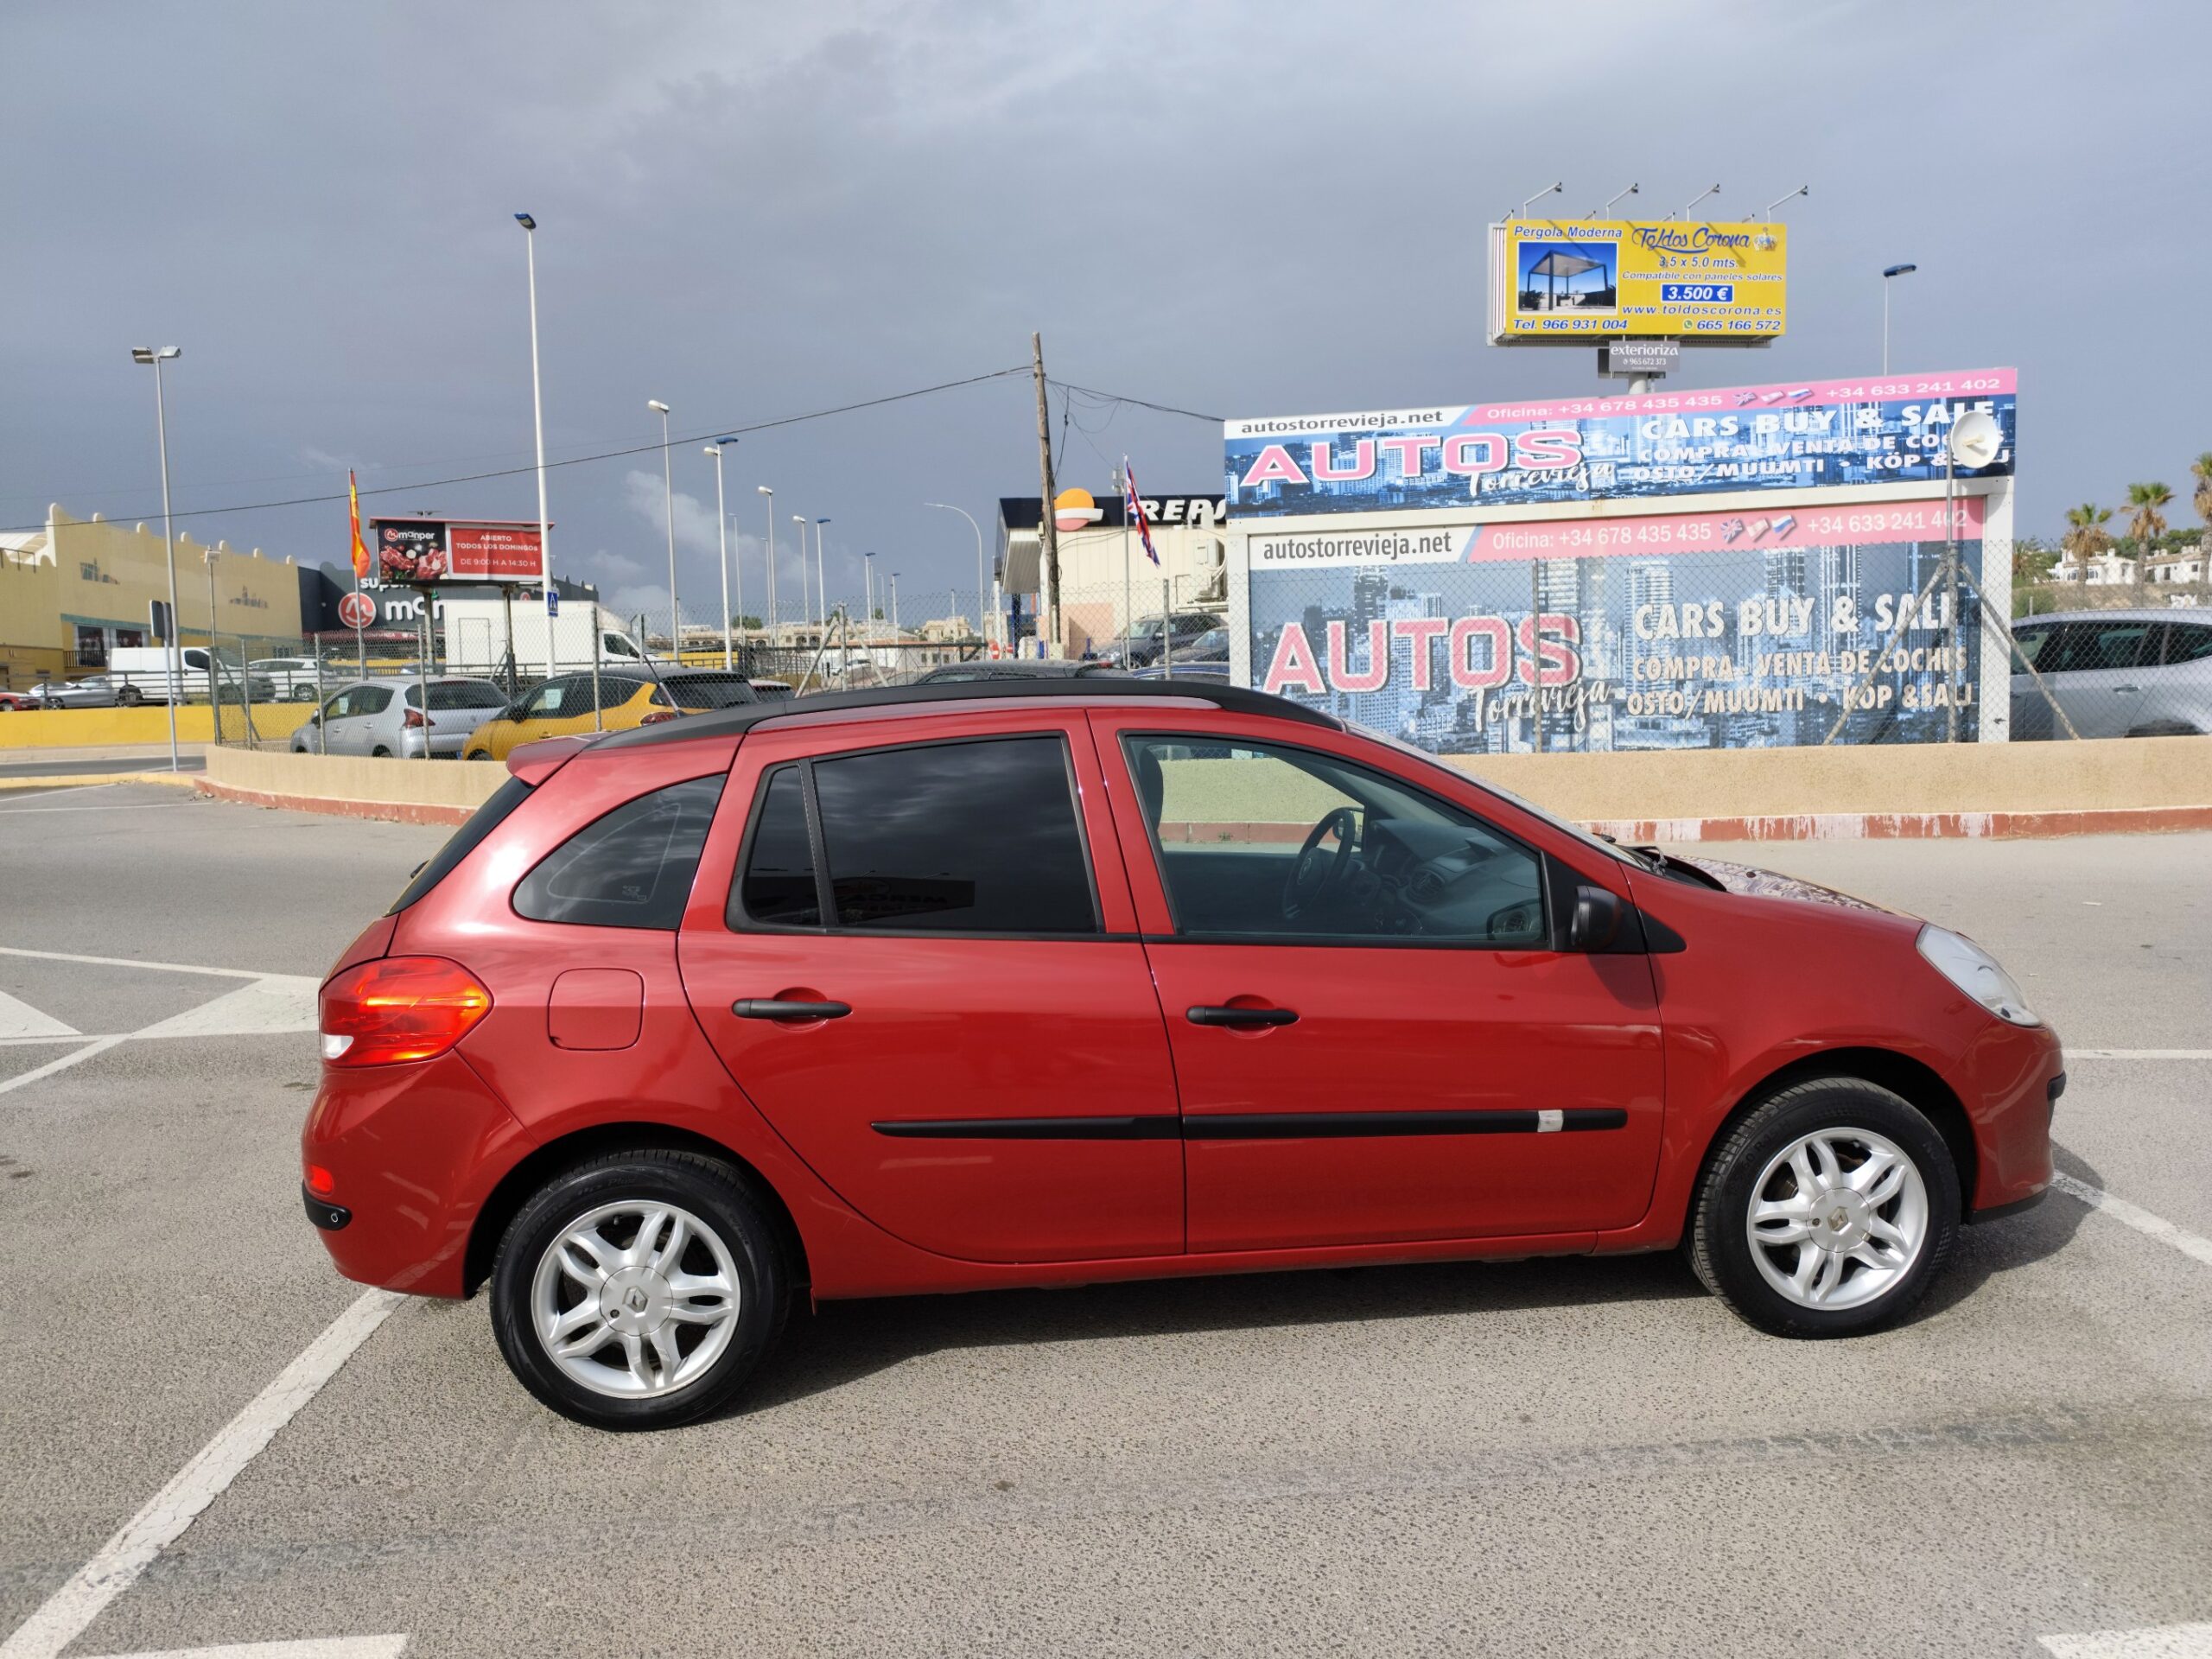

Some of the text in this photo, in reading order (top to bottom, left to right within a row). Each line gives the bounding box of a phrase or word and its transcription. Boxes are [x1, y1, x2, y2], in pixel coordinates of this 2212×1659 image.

[1567, 226, 1623, 237] Moderna
[1632, 226, 1751, 251] Toldos Corona
[1622, 270, 1680, 281] Compatible
[1704, 272, 1743, 282] paneles
[1746, 272, 1783, 281] solares
[1667, 286, 1728, 301] 3.500 €
[1622, 304, 1782, 316] www.toldoscorona.es
[1514, 319, 1628, 329] Tel. 966 931 004
[1696, 320, 1781, 330] 665 166 572
[1610, 343, 1679, 356] exterioriza
[1827, 378, 2000, 398] +34 633 241 402
[1487, 395, 1723, 419] Oficina: +34 678 435 435
[1241, 410, 1444, 434] autostorrevieja.net
[1641, 415, 1739, 440] CARS
[1755, 410, 1838, 434] BUY
[1854, 407, 1885, 429] &
[1239, 429, 1584, 487] AUTOS
[1639, 443, 1749, 463] COMPRA
[1774, 438, 1854, 456] VENTA
[1862, 435, 1896, 451] DE
[1866, 451, 1921, 469] KÖP
[1469, 462, 1616, 497] Torrevieja
[1808, 509, 1967, 534] +34 633 241 402
[398, 531, 435, 541] manper
[1263, 531, 1452, 561] autostorrevieja.net
[1492, 522, 1712, 550] Oficina: +34 678 435 435
[1635, 601, 1726, 640] CARS
[1738, 597, 1815, 636] BUY
[1831, 595, 1859, 633] &
[1262, 613, 1583, 695] AUTOS
[1632, 654, 1736, 681] COMPRA
[1756, 650, 1832, 677] VENTA
[1840, 649, 1870, 674] DE
